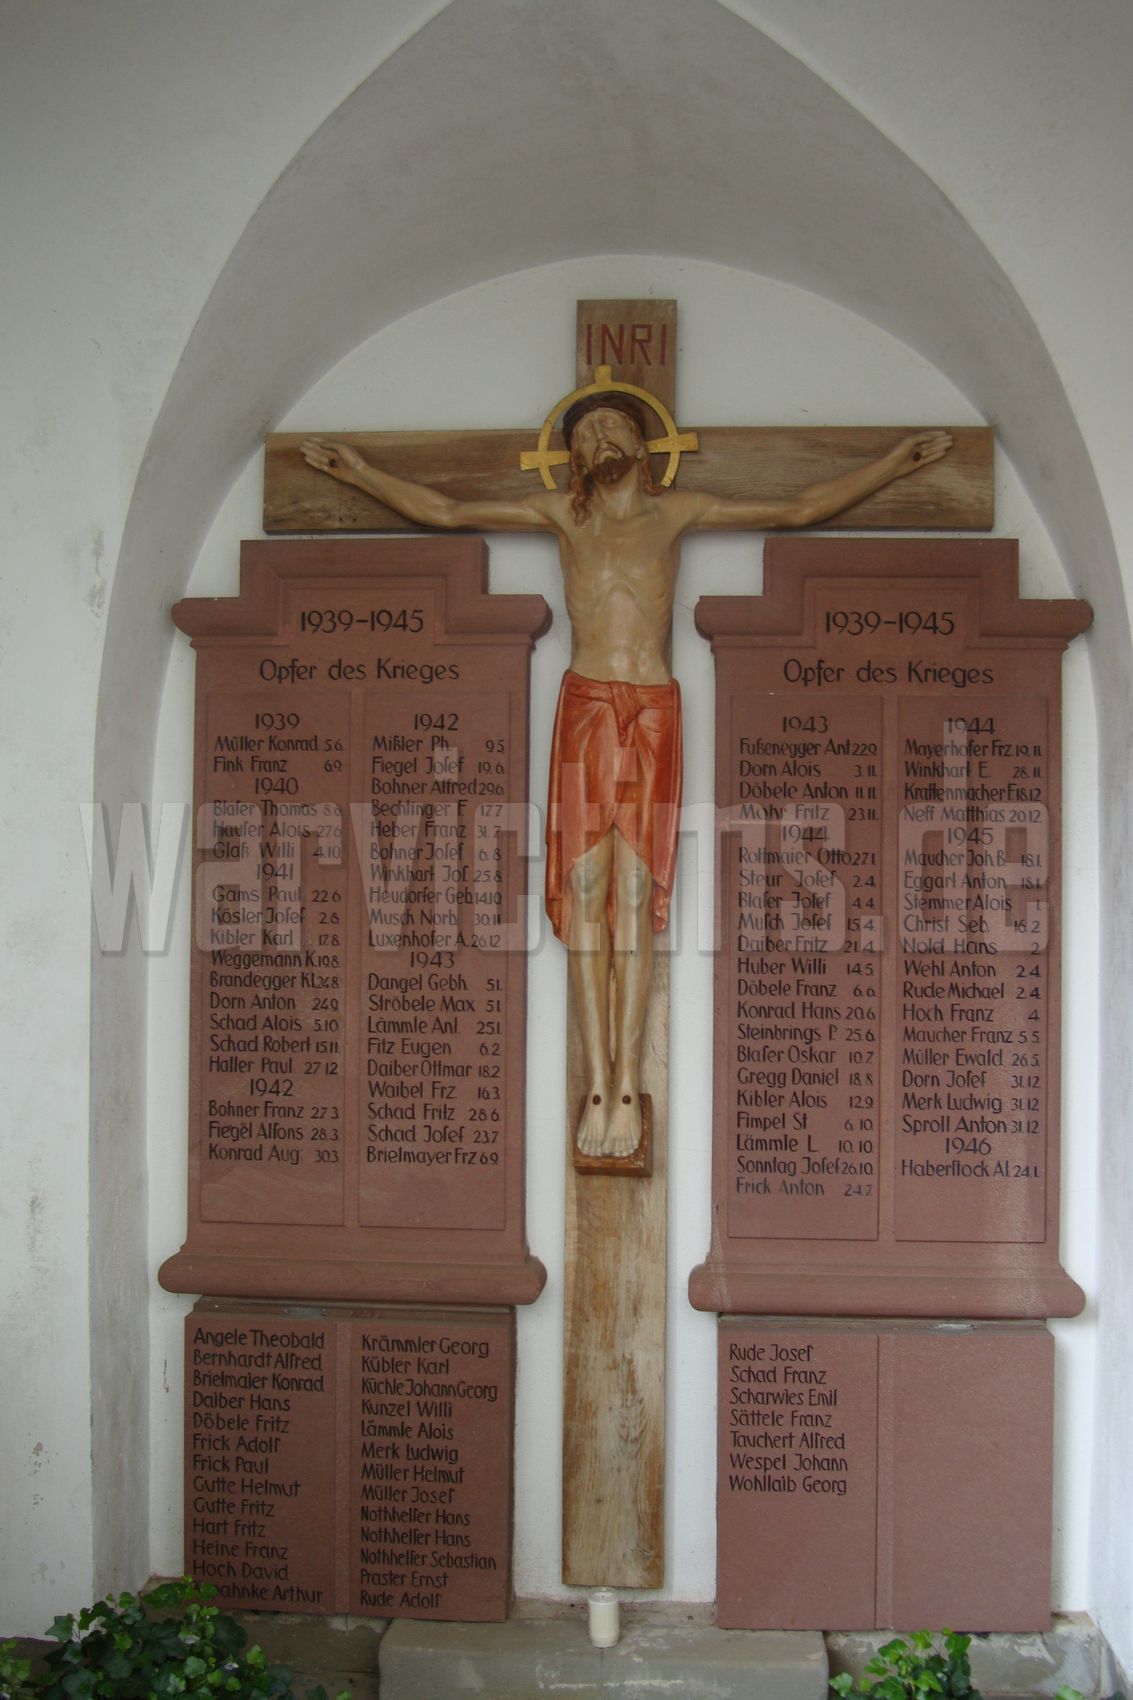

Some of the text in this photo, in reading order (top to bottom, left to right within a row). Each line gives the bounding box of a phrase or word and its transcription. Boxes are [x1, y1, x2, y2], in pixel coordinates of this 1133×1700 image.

[587, 324, 667, 366] INRI
[260, 658, 459, 684] Opfer des Krieges
[784, 658, 994, 688] Opfer des Krieges
[256, 713, 300, 731] 1939
[414, 713, 458, 731] 1942
[783, 716, 828, 733] 1943
[948, 717, 995, 735] 1944
[215, 735, 319, 752] Müller Konrad
[213, 755, 288, 772] Fink Franz
[740, 760, 821, 777] Dorn Alois
[255, 777, 299, 795] 1940
[372, 778, 428, 795] Bohner
[740, 781, 848, 799] Döbele Anton
[948, 827, 994, 846] 1945
[212, 949, 302, 970] Weggemann
[411, 951, 454, 969] 1943
[738, 957, 826, 975] Huber Willi
[904, 960, 996, 977] Wehl Anton
[210, 970, 297, 991] Brandegger
[368, 973, 422, 993] Dangel
[738, 979, 837, 997] Döbele Franz
[903, 981, 1004, 999] Rude Michael
[210, 992, 295, 1010] Dorn Anton
[369, 994, 475, 1012] Ströbele Max
[737, 1001, 841, 1020] Konrad Hans
[903, 1003, 994, 1022] Hoch Franz
[210, 1014, 302, 1031] Schad Alois
[210, 1034, 310, 1053] Schad Robert
[737, 1023, 821, 1045] Steinbrings
[903, 1026, 1013, 1044] Maucher Franz
[401, 1038, 451, 1059] Eugen
[903, 1048, 1003, 1067] Müller Ewald
[209, 1056, 292, 1074] Haller Paul
[368, 1059, 472, 1077] Daiber Ottmar
[250, 1078, 293, 1096] 1942
[737, 1067, 838, 1088] Gregg Daniel
[368, 1080, 423, 1099] Waibel
[737, 1089, 827, 1108] Kibler Alois
[209, 1100, 304, 1119] Bohner Franz
[368, 1102, 455, 1120] Schad Fritz
[902, 1092, 1003, 1114] Merk Ludwig
[209, 1121, 252, 1142] Fiegel
[902, 1114, 1007, 1136] Sproll Anton
[209, 1143, 262, 1161] Konrad
[946, 1137, 992, 1155] 1946
[367, 1146, 452, 1166] Brielmayer
[193, 1328, 325, 1350] Angele Theobald
[362, 1334, 489, 1358] Krämmler Georg
[193, 1349, 272, 1368] Bernhardt
[729, 1344, 766, 1361] Rude
[362, 1355, 449, 1376] Kübler Karl
[730, 1365, 826, 1384] Schad Franz
[193, 1369, 324, 1392] Brielmaier Konrad
[405, 1378, 457, 1397] Johann
[456, 1381, 497, 1402] Georg
[193, 1391, 290, 1411] Daiber Hans
[729, 1387, 837, 1406] Scharwies Emil
[416, 1400, 452, 1418] Willi
[730, 1409, 832, 1428] Sättele Franz
[193, 1412, 290, 1433] Döbele Fritz
[361, 1420, 454, 1440] Lämmle Alois
[193, 1433, 230, 1451] Frick
[730, 1431, 795, 1448] Tauchert
[362, 1442, 458, 1465] Merk Ludwig
[730, 1453, 848, 1473] Wespel Johann
[193, 1454, 268, 1474] Frick Paul
[361, 1463, 465, 1484] Müller Helmut
[193, 1475, 301, 1497] Gutte Helmut
[361, 1484, 408, 1502] Müller
[729, 1475, 846, 1496] Wohllaib Georg
[193, 1497, 275, 1517] Gutte Fritz
[435, 1508, 470, 1526] Hans
[193, 1517, 266, 1538] Hart Fritz
[435, 1529, 471, 1547] Hans
[192, 1538, 288, 1560] Heine Franz
[193, 1559, 289, 1581] Hoch David
[430, 1551, 496, 1570] Sebastian
[411, 1571, 448, 1589] Ernst
[272, 1585, 323, 1603] Arthur
[360, 1589, 394, 1607] Rude
